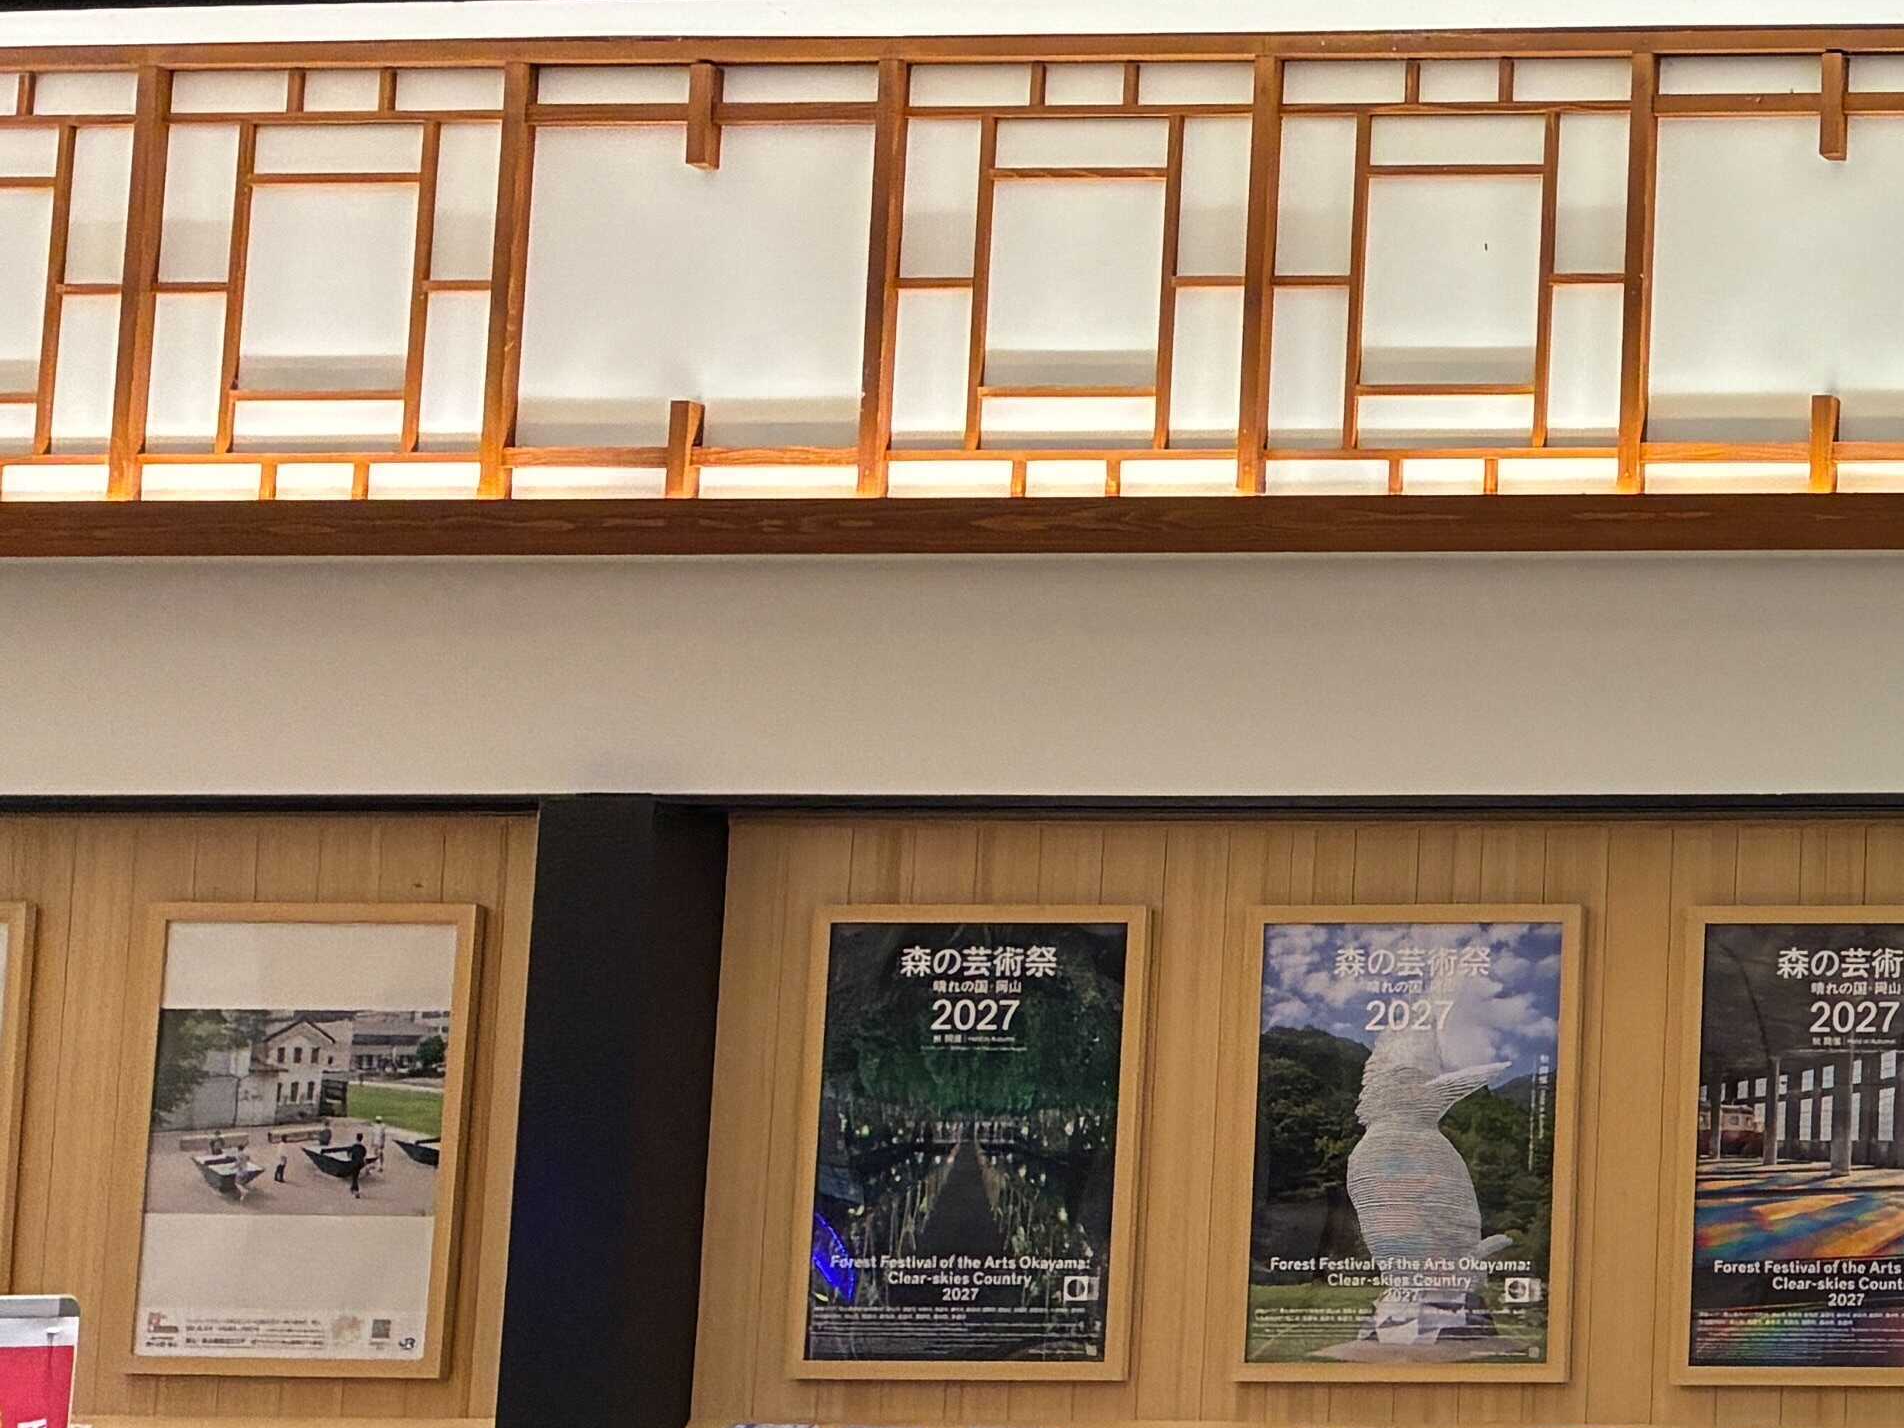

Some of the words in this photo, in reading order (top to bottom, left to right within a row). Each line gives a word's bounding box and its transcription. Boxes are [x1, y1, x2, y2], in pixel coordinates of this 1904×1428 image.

[900, 945, 1058, 978] 森の芸術祭
[1334, 946, 1493, 979] 森の芸術祭
[930, 999, 1021, 1032] 2027
[1365, 1000, 1455, 1033] 2027
[1809, 1000, 1900, 1035] 2027
[830, 1255, 877, 1269] Forest
[880, 1254, 936, 1269] Festival
[939, 1254, 954, 1269] of
[957, 1254, 981, 1269] the
[984, 1255, 1016, 1269] Arts
[1020, 1255, 1091, 1273] Okayama:
[1271, 1257, 1315, 1271] Forest
[1319, 1257, 1375, 1271] Festival
[1379, 1257, 1394, 1271] of
[1397, 1257, 1420, 1271] the
[1424, 1258, 1455, 1271] Arts
[1458, 1258, 1531, 1274] Okayama:
[1714, 1259, 1761, 1274] Forest
[1764, 1259, 1821, 1274] Festival
[1823, 1259, 1839, 1274] of
[1842, 1259, 1867, 1274] the
[1870, 1259, 1902, 1274] Arts
[888, 1271, 969, 1286] Clear-skies
[973, 1272, 1032, 1288] Country
[1327, 1274, 1410, 1288] Clear-skies
[1413, 1275, 1471, 1290] Country
[1772, 1276, 1855, 1291] Clear-skies
[942, 1288, 979, 1301] 2027
[1828, 1293, 1865, 1307] 2027
